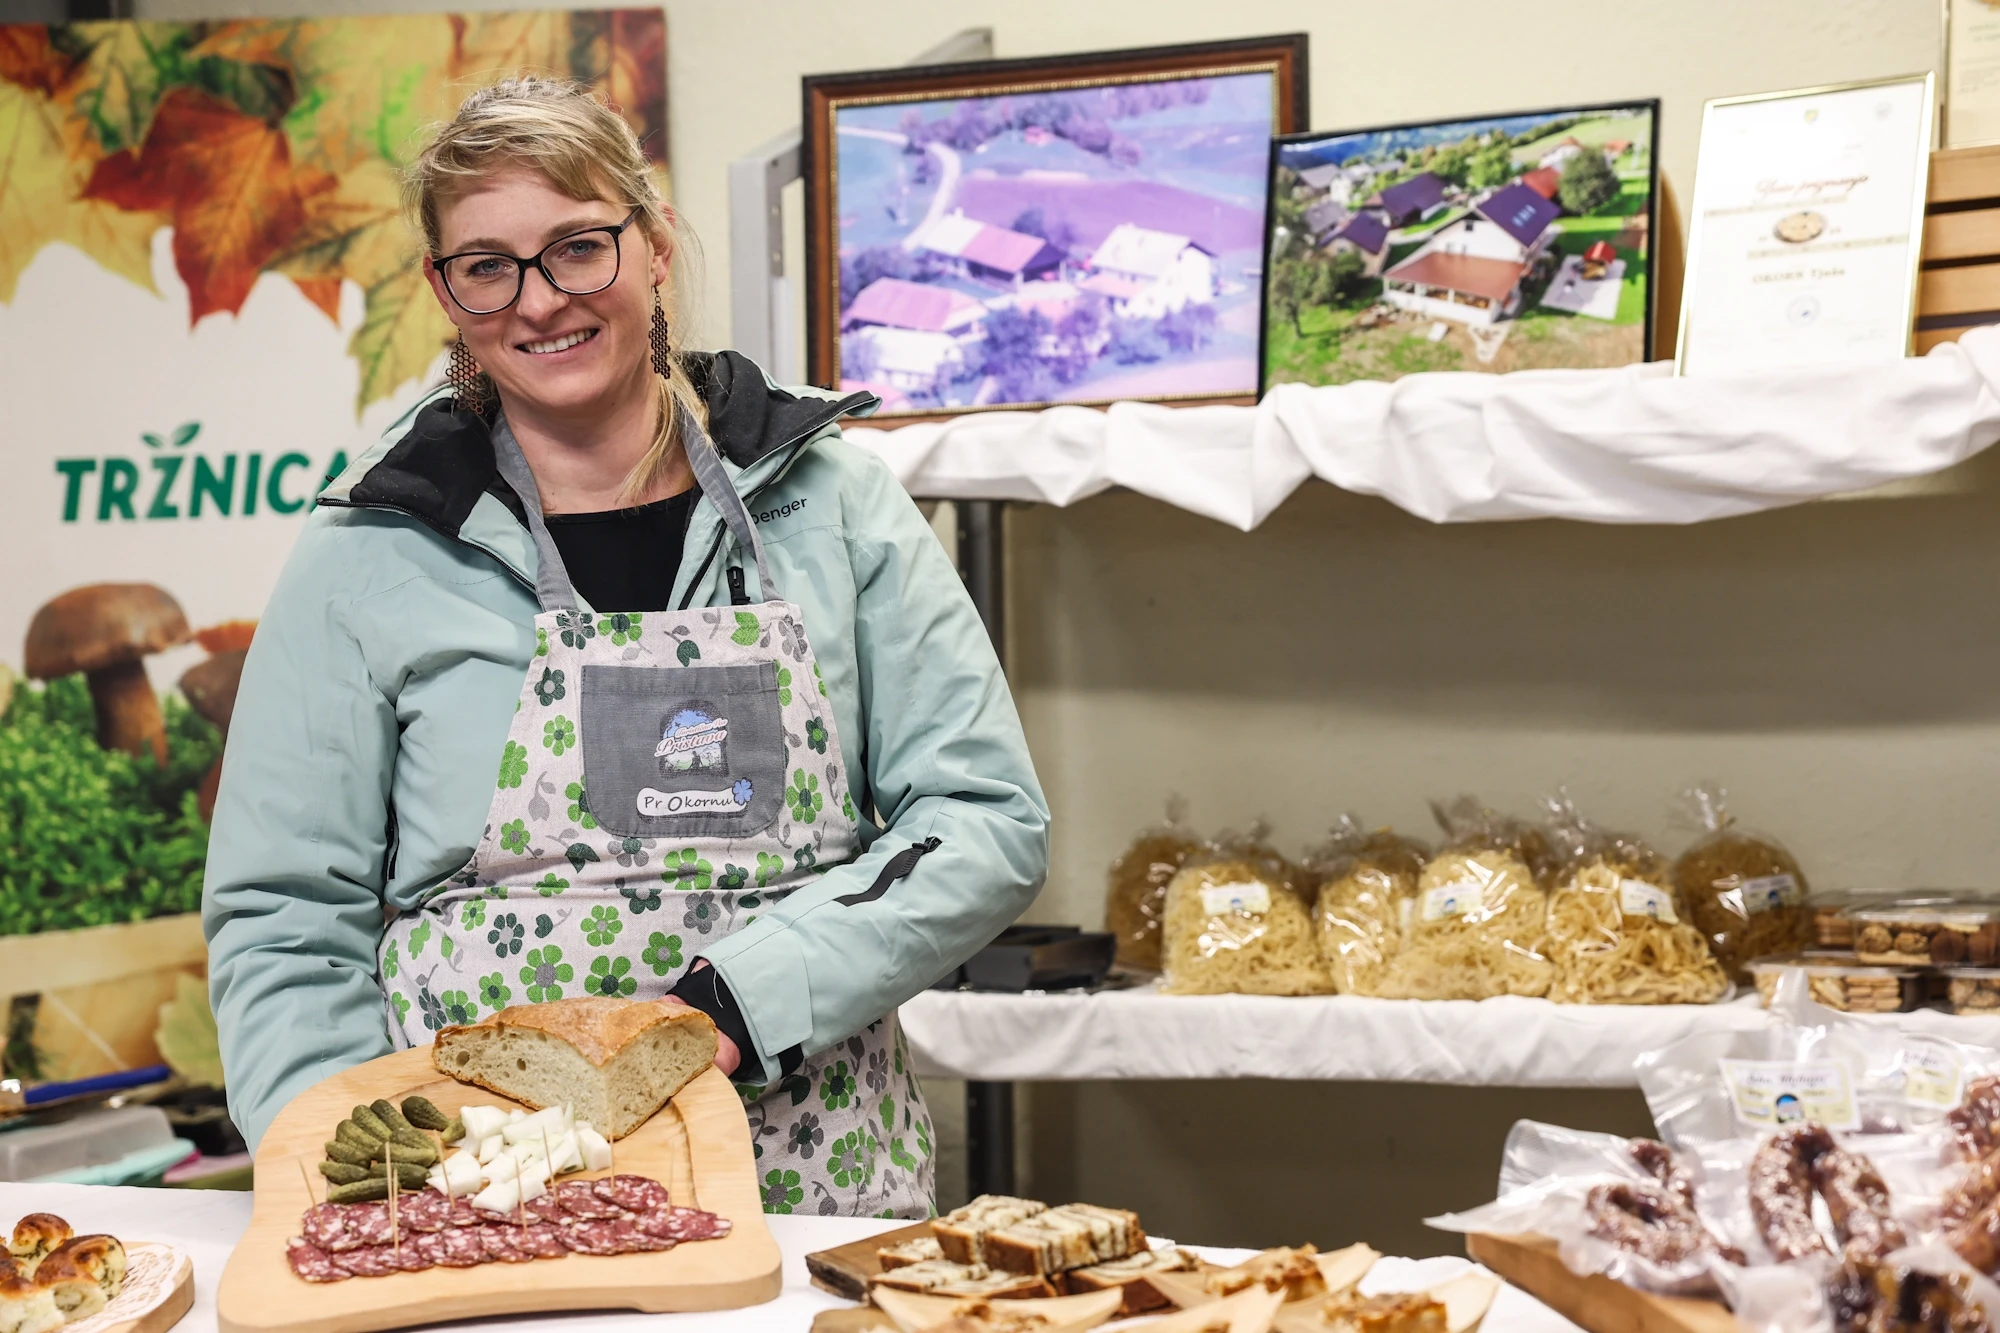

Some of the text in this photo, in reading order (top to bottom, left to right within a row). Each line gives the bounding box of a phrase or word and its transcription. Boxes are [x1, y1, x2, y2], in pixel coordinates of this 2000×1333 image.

[656, 731, 724, 753] Pristava
[644, 796, 732, 812] Pr Okornu
